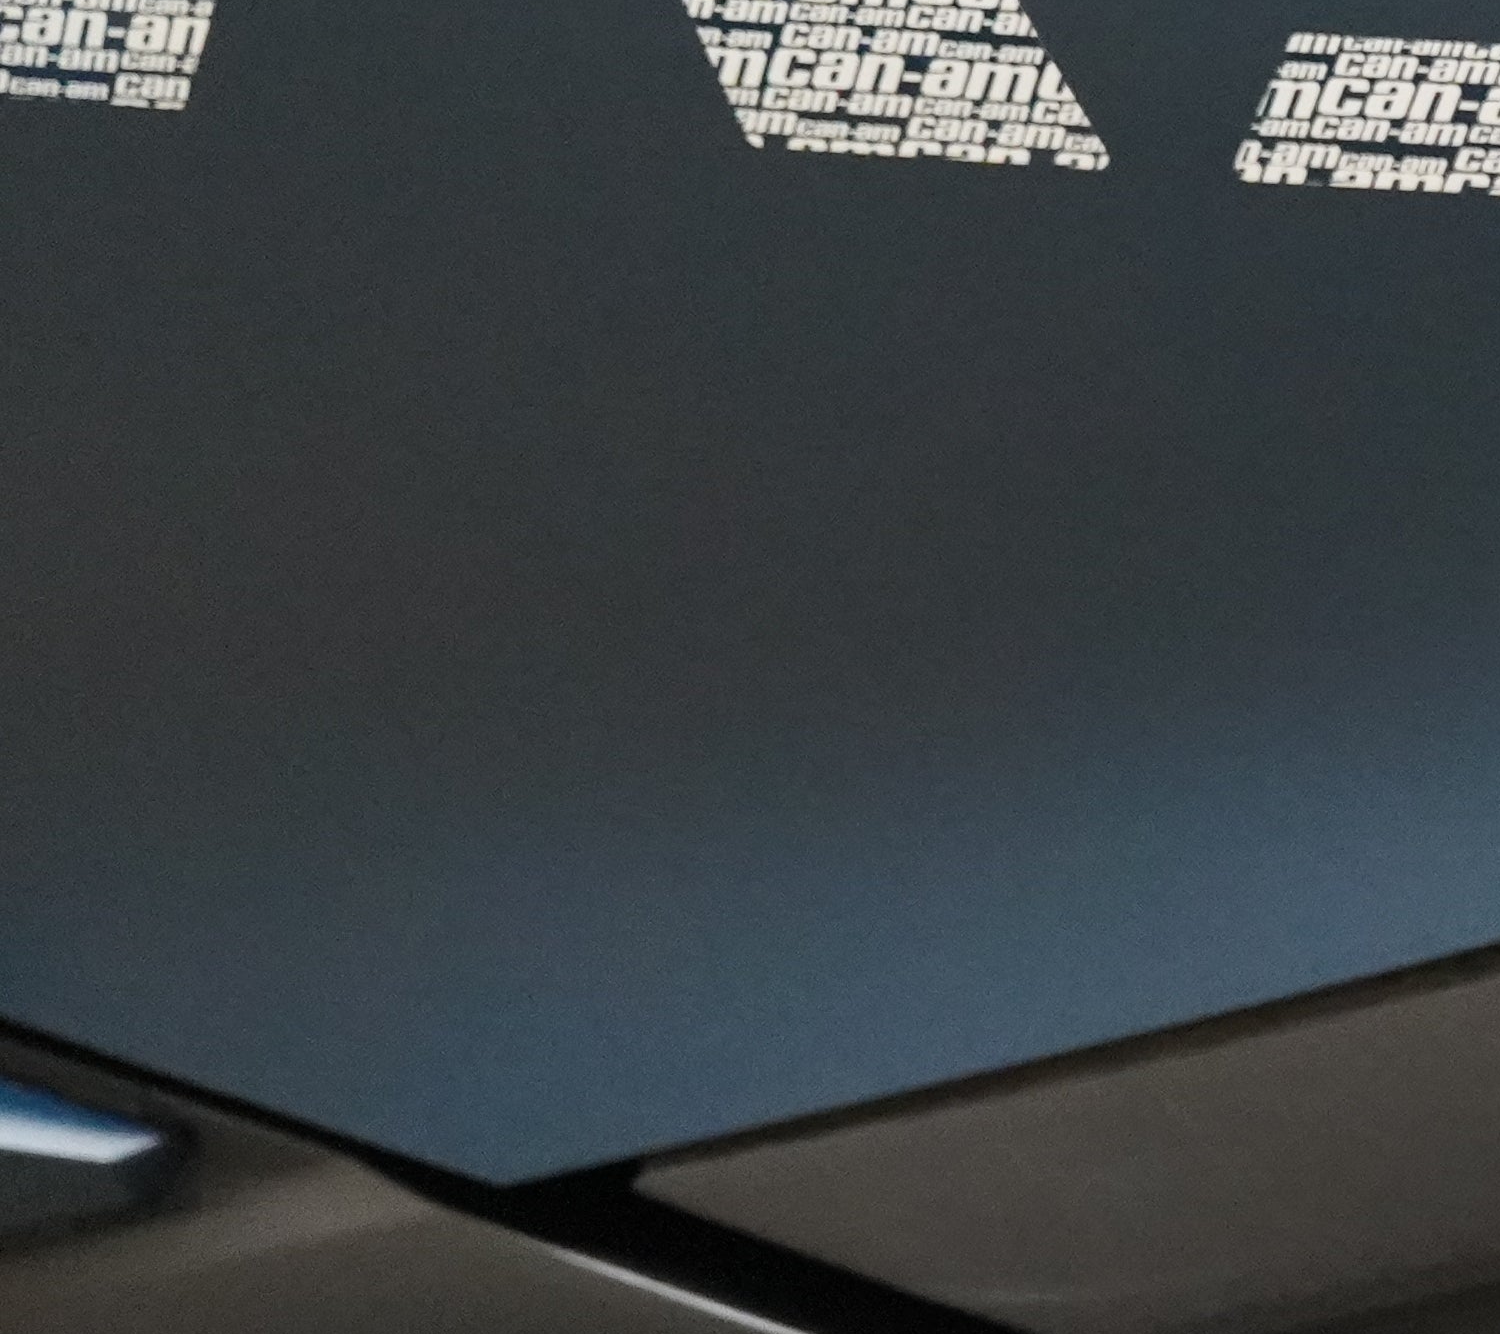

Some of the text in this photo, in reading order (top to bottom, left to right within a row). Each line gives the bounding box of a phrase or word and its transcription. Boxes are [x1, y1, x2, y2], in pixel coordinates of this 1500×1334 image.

[781, 22, 939, 57] can-am
[768, 47, 1038, 103] can-am
[1335, 51, 1499, 87] can-am
[763, 86, 912, 118] can-am
[906, 116, 1066, 150] can-am
[1311, 116, 1466, 148] can-am
